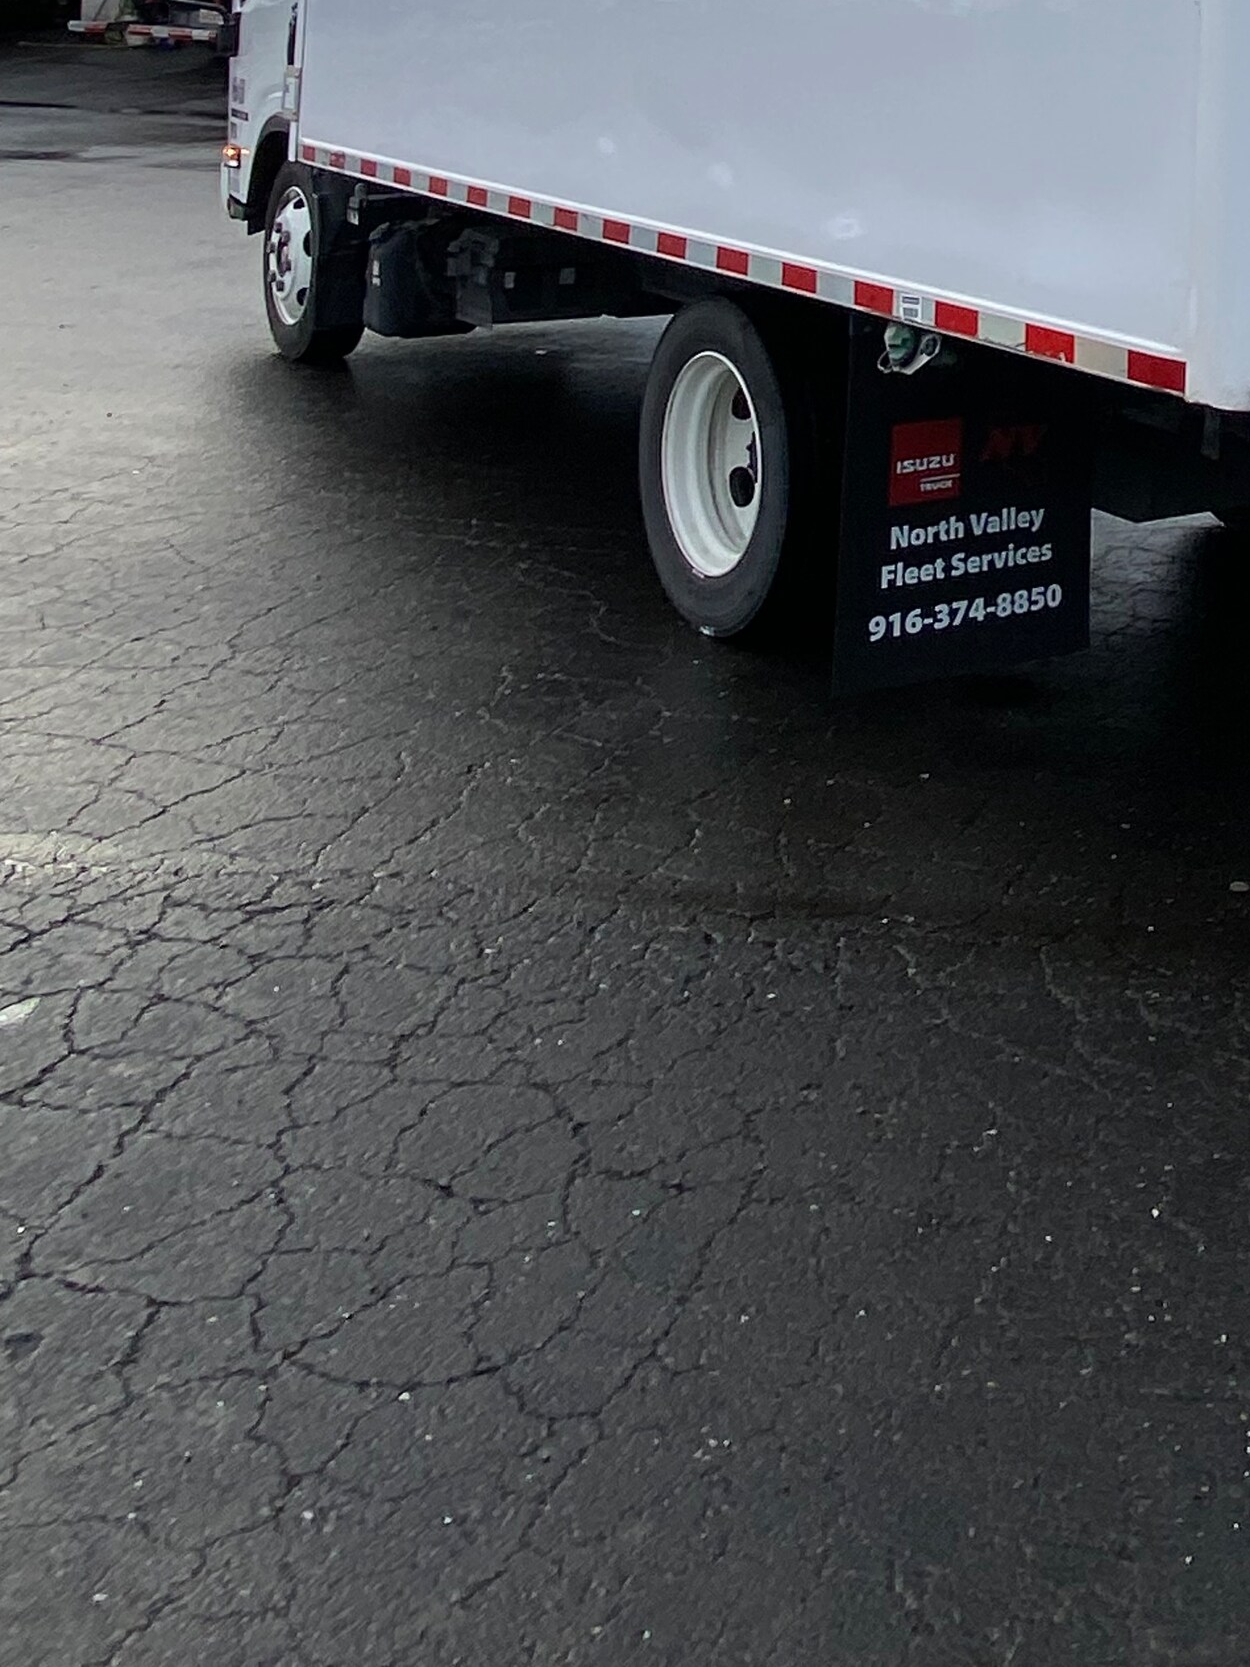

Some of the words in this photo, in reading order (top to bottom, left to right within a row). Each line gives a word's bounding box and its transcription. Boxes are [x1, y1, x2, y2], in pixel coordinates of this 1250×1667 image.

[896, 453, 955, 474] ISUZU
[920, 480, 953, 492] TRUCK
[890, 516, 965, 550] North
[970, 507, 1045, 536] Valley
[881, 558, 946, 589] Fleet
[951, 543, 1053, 577] Services
[868, 584, 1063, 642] 916-374-8850
